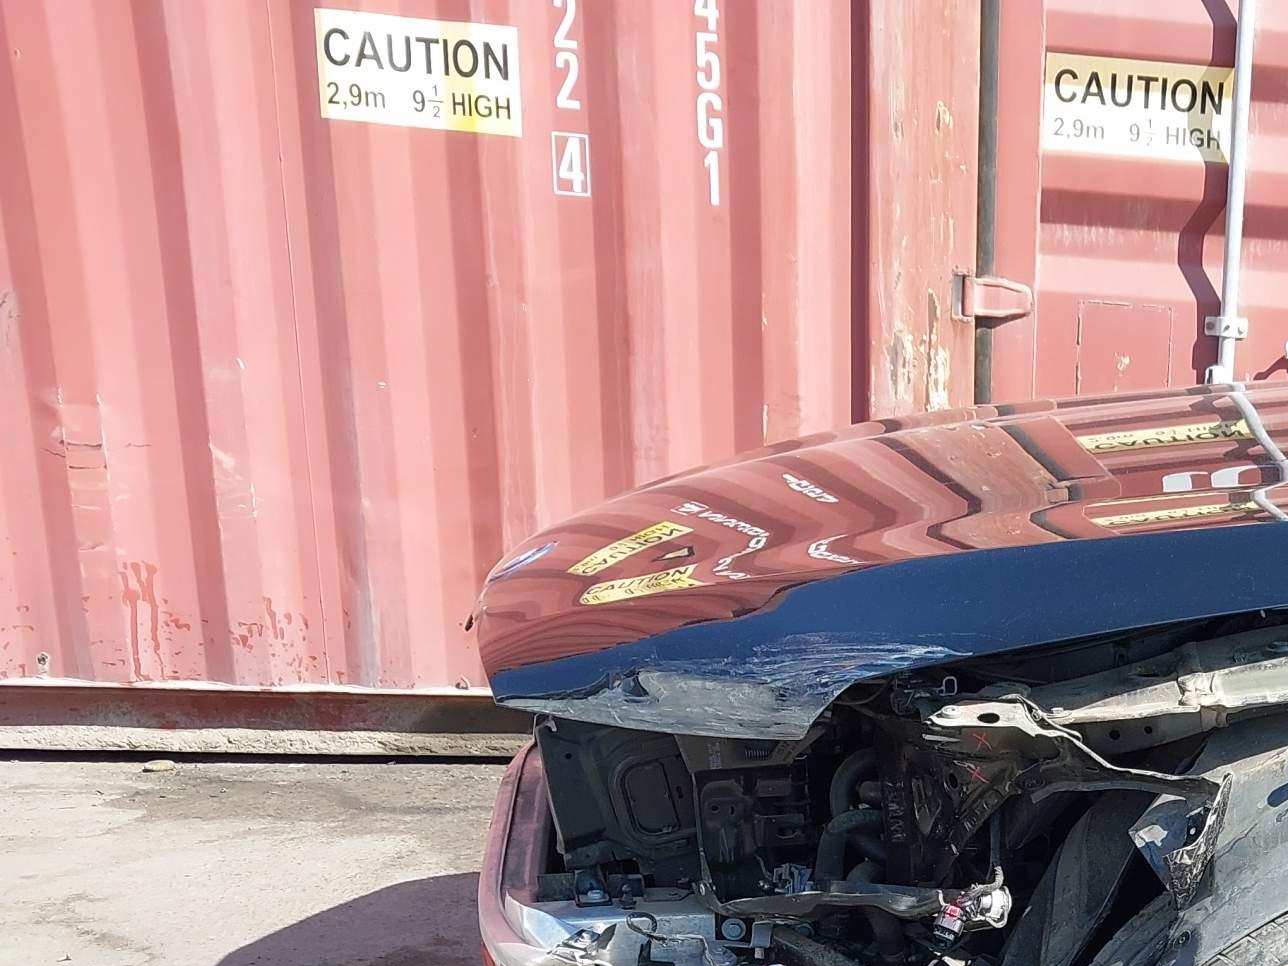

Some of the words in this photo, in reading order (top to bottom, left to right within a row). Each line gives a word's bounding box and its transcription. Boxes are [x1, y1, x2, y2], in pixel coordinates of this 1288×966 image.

[323, 27, 509, 81] CAUTION
[327, 82, 386, 109] 2,9m
[452, 92, 511, 120] HIGH
[694, 0, 723, 206] 45G1
[1054, 68, 1224, 115] CAUTION
[1053, 116, 1105, 140] 2,9m
[1166, 126, 1221, 150] HIGH
[559, 136, 585, 193] 4
